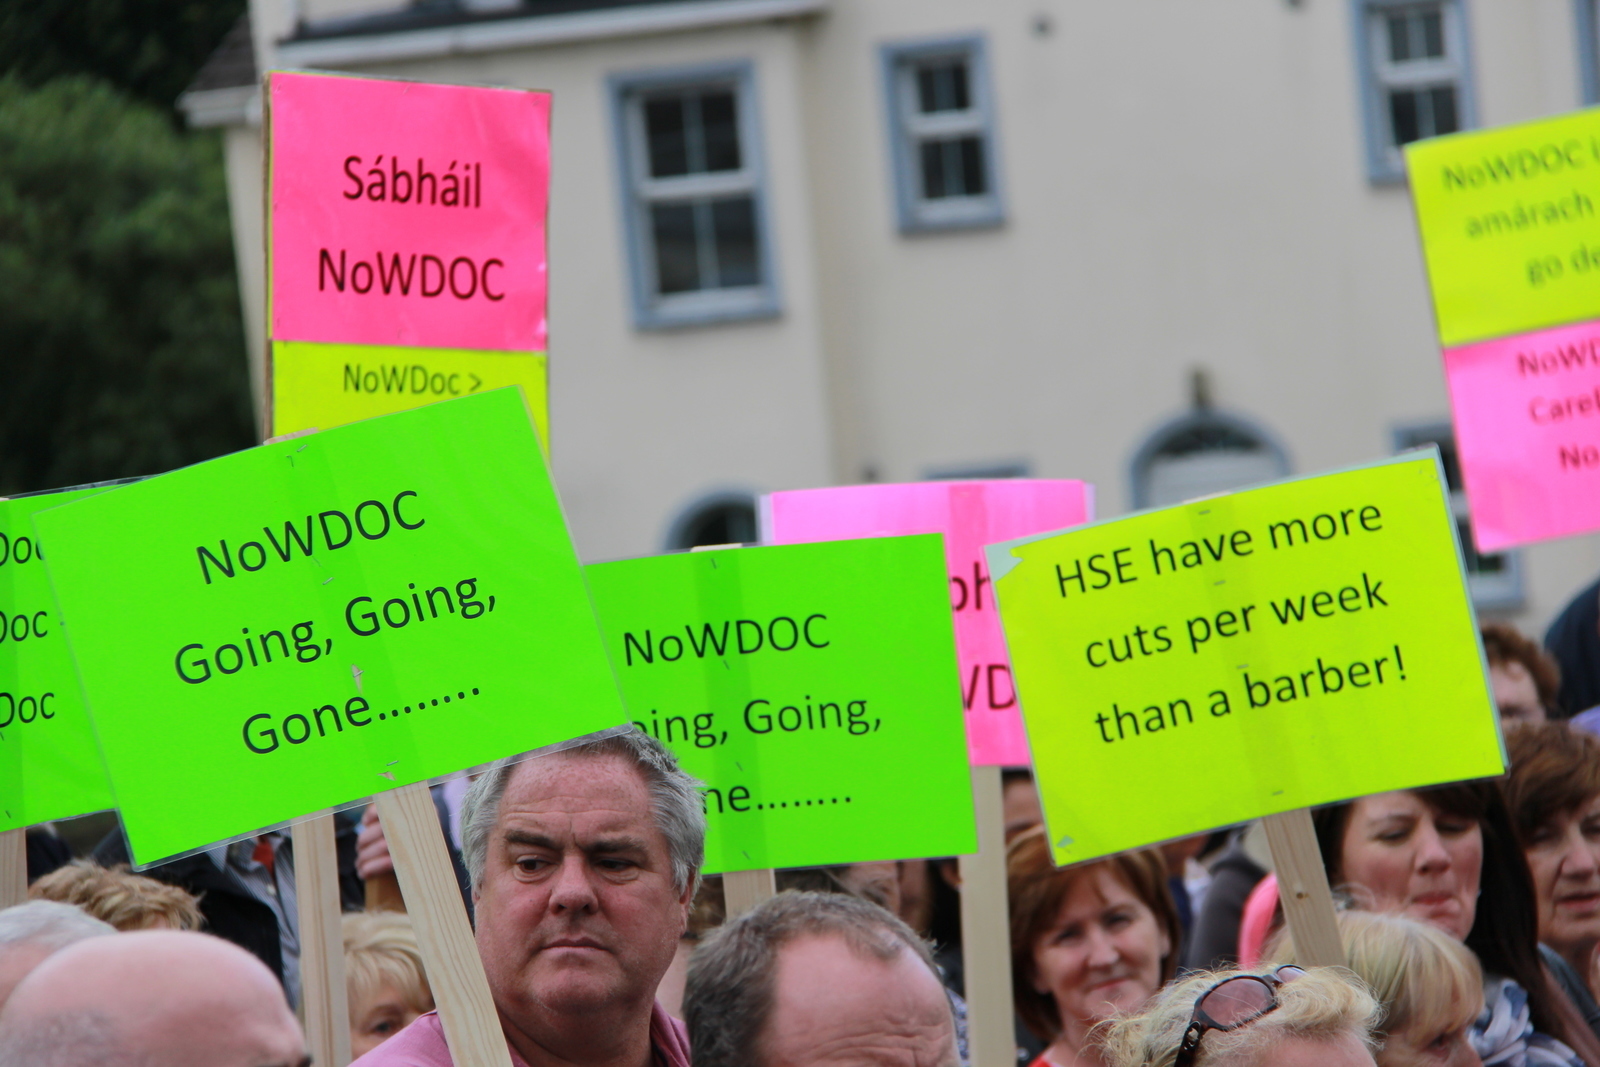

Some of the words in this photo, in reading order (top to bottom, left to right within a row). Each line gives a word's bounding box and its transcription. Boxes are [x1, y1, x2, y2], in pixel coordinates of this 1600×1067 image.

[343, 155, 481, 209] Sábháil
[1443, 138, 1584, 190] NoWDOC
[319, 248, 505, 301] NoWDOC
[344, 364, 460, 395] NoWDoc
[196, 490, 426, 585] NoWDOC
[1055, 547, 1138, 598] HSE
[1149, 528, 1254, 575] have
[1269, 504, 1383, 549] more
[174, 620, 333, 684] Going,
[345, 577, 496, 637] Going,
[624, 614, 830, 666] NoWDOC
[1086, 624, 1172, 668] cuts
[1187, 604, 1256, 653] per
[1270, 572, 1388, 625] week
[743, 695, 882, 735] Going,
[1095, 698, 1194, 743] than
[1208, 688, 1231, 717] a
[1243, 645, 1407, 709] barber!
